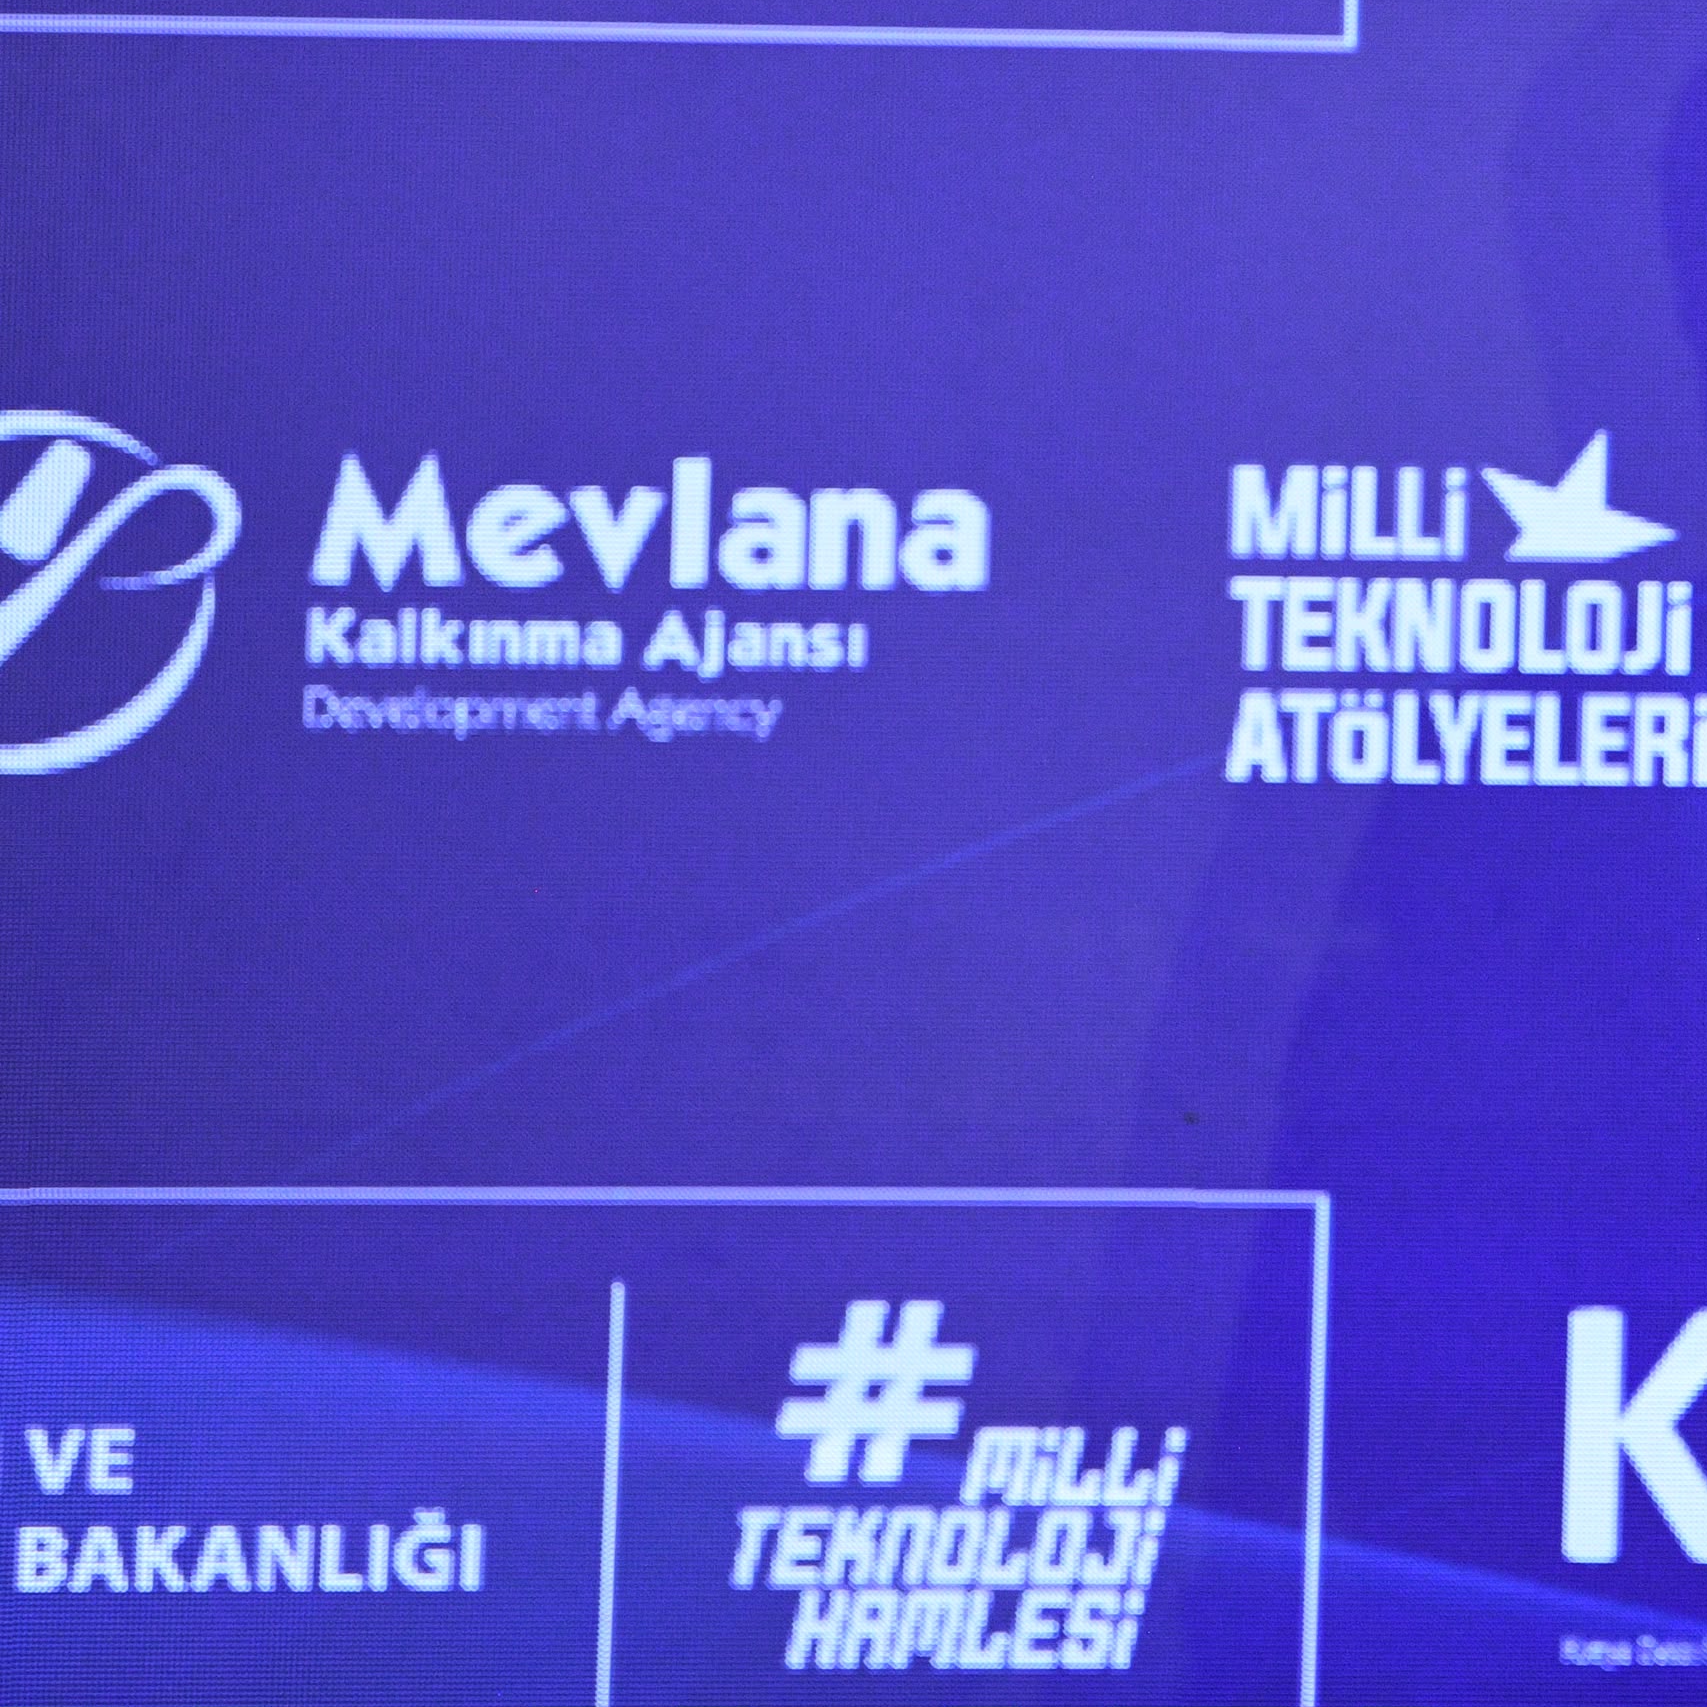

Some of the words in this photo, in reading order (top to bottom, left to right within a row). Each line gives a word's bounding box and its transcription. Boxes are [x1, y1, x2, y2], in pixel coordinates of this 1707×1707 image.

[313, 457, 988, 591] Mevlana
[308, 607, 622, 665] Kalkınma
[644, 610, 866, 678] Ajansı
[304, 685, 597, 737] Development
[611, 688, 781, 741] Agency
[27, 1427, 134, 1492] VE
[16, 1510, 483, 1592] BAKANLIĞI
